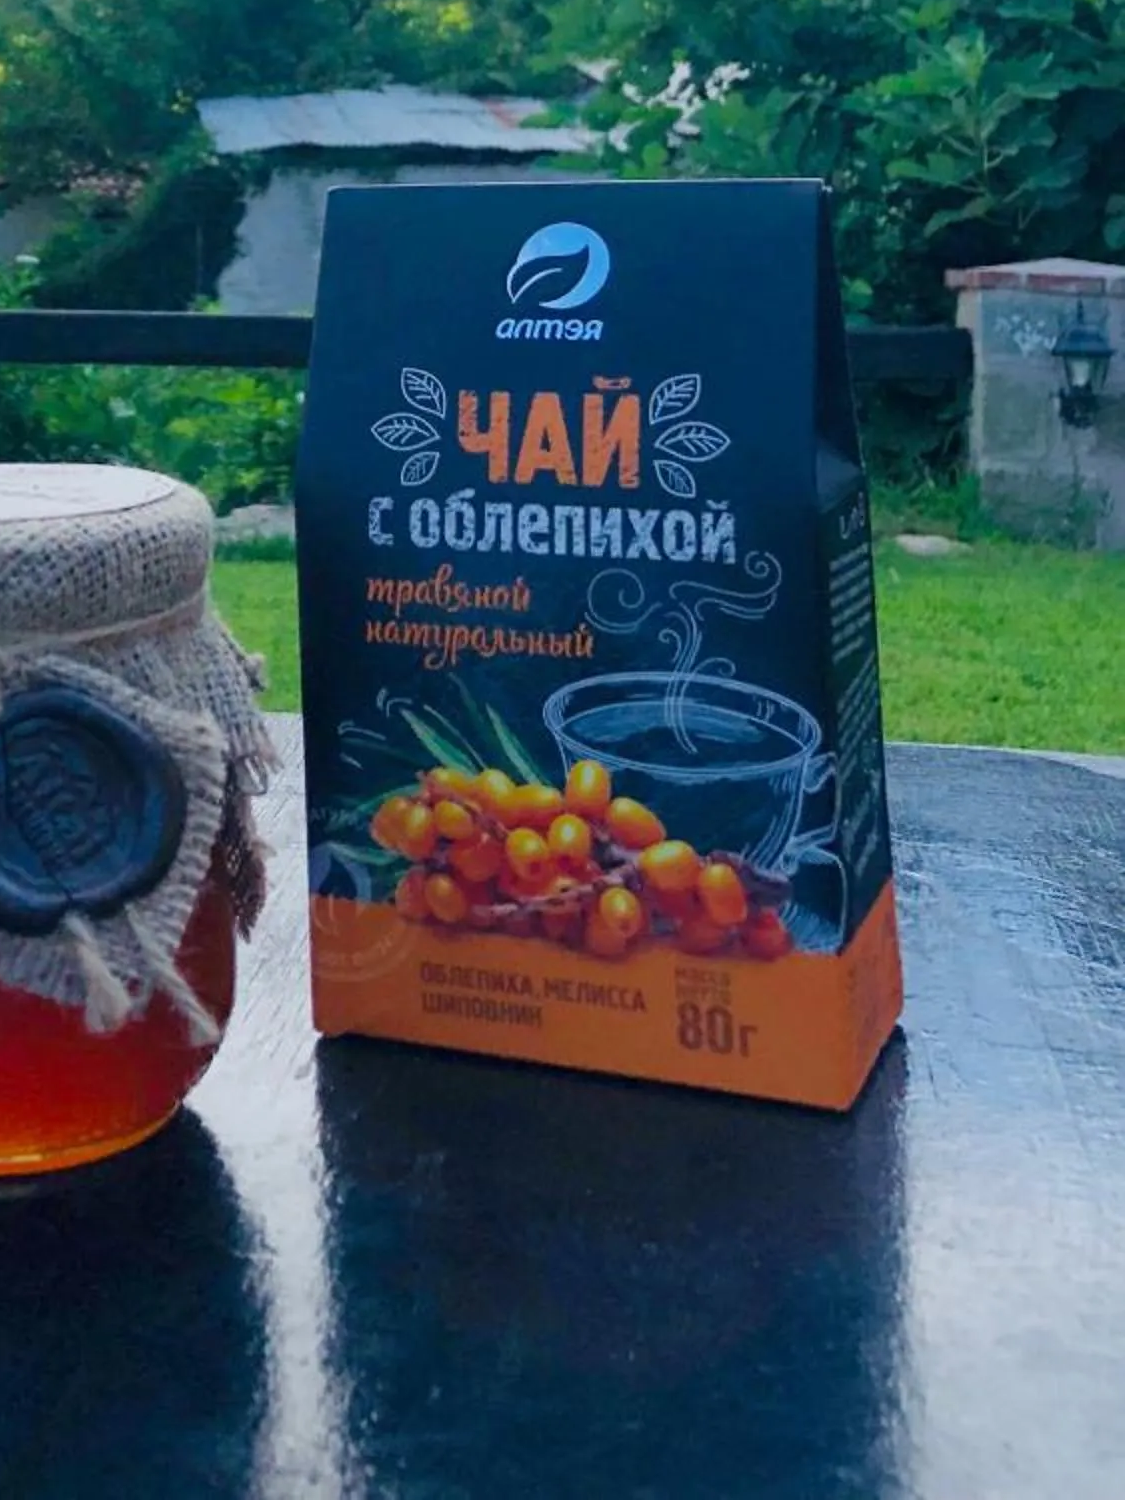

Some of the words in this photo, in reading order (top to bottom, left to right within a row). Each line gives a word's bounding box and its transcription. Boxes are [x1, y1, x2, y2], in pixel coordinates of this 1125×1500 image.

[456, 375, 641, 490] ЧАЙ
[366, 562, 532, 618] травяной
[365, 619, 595, 671] натуральный
[543, 977, 648, 1013] МЕЛИССА
[676, 1002, 759, 1058] 80г
